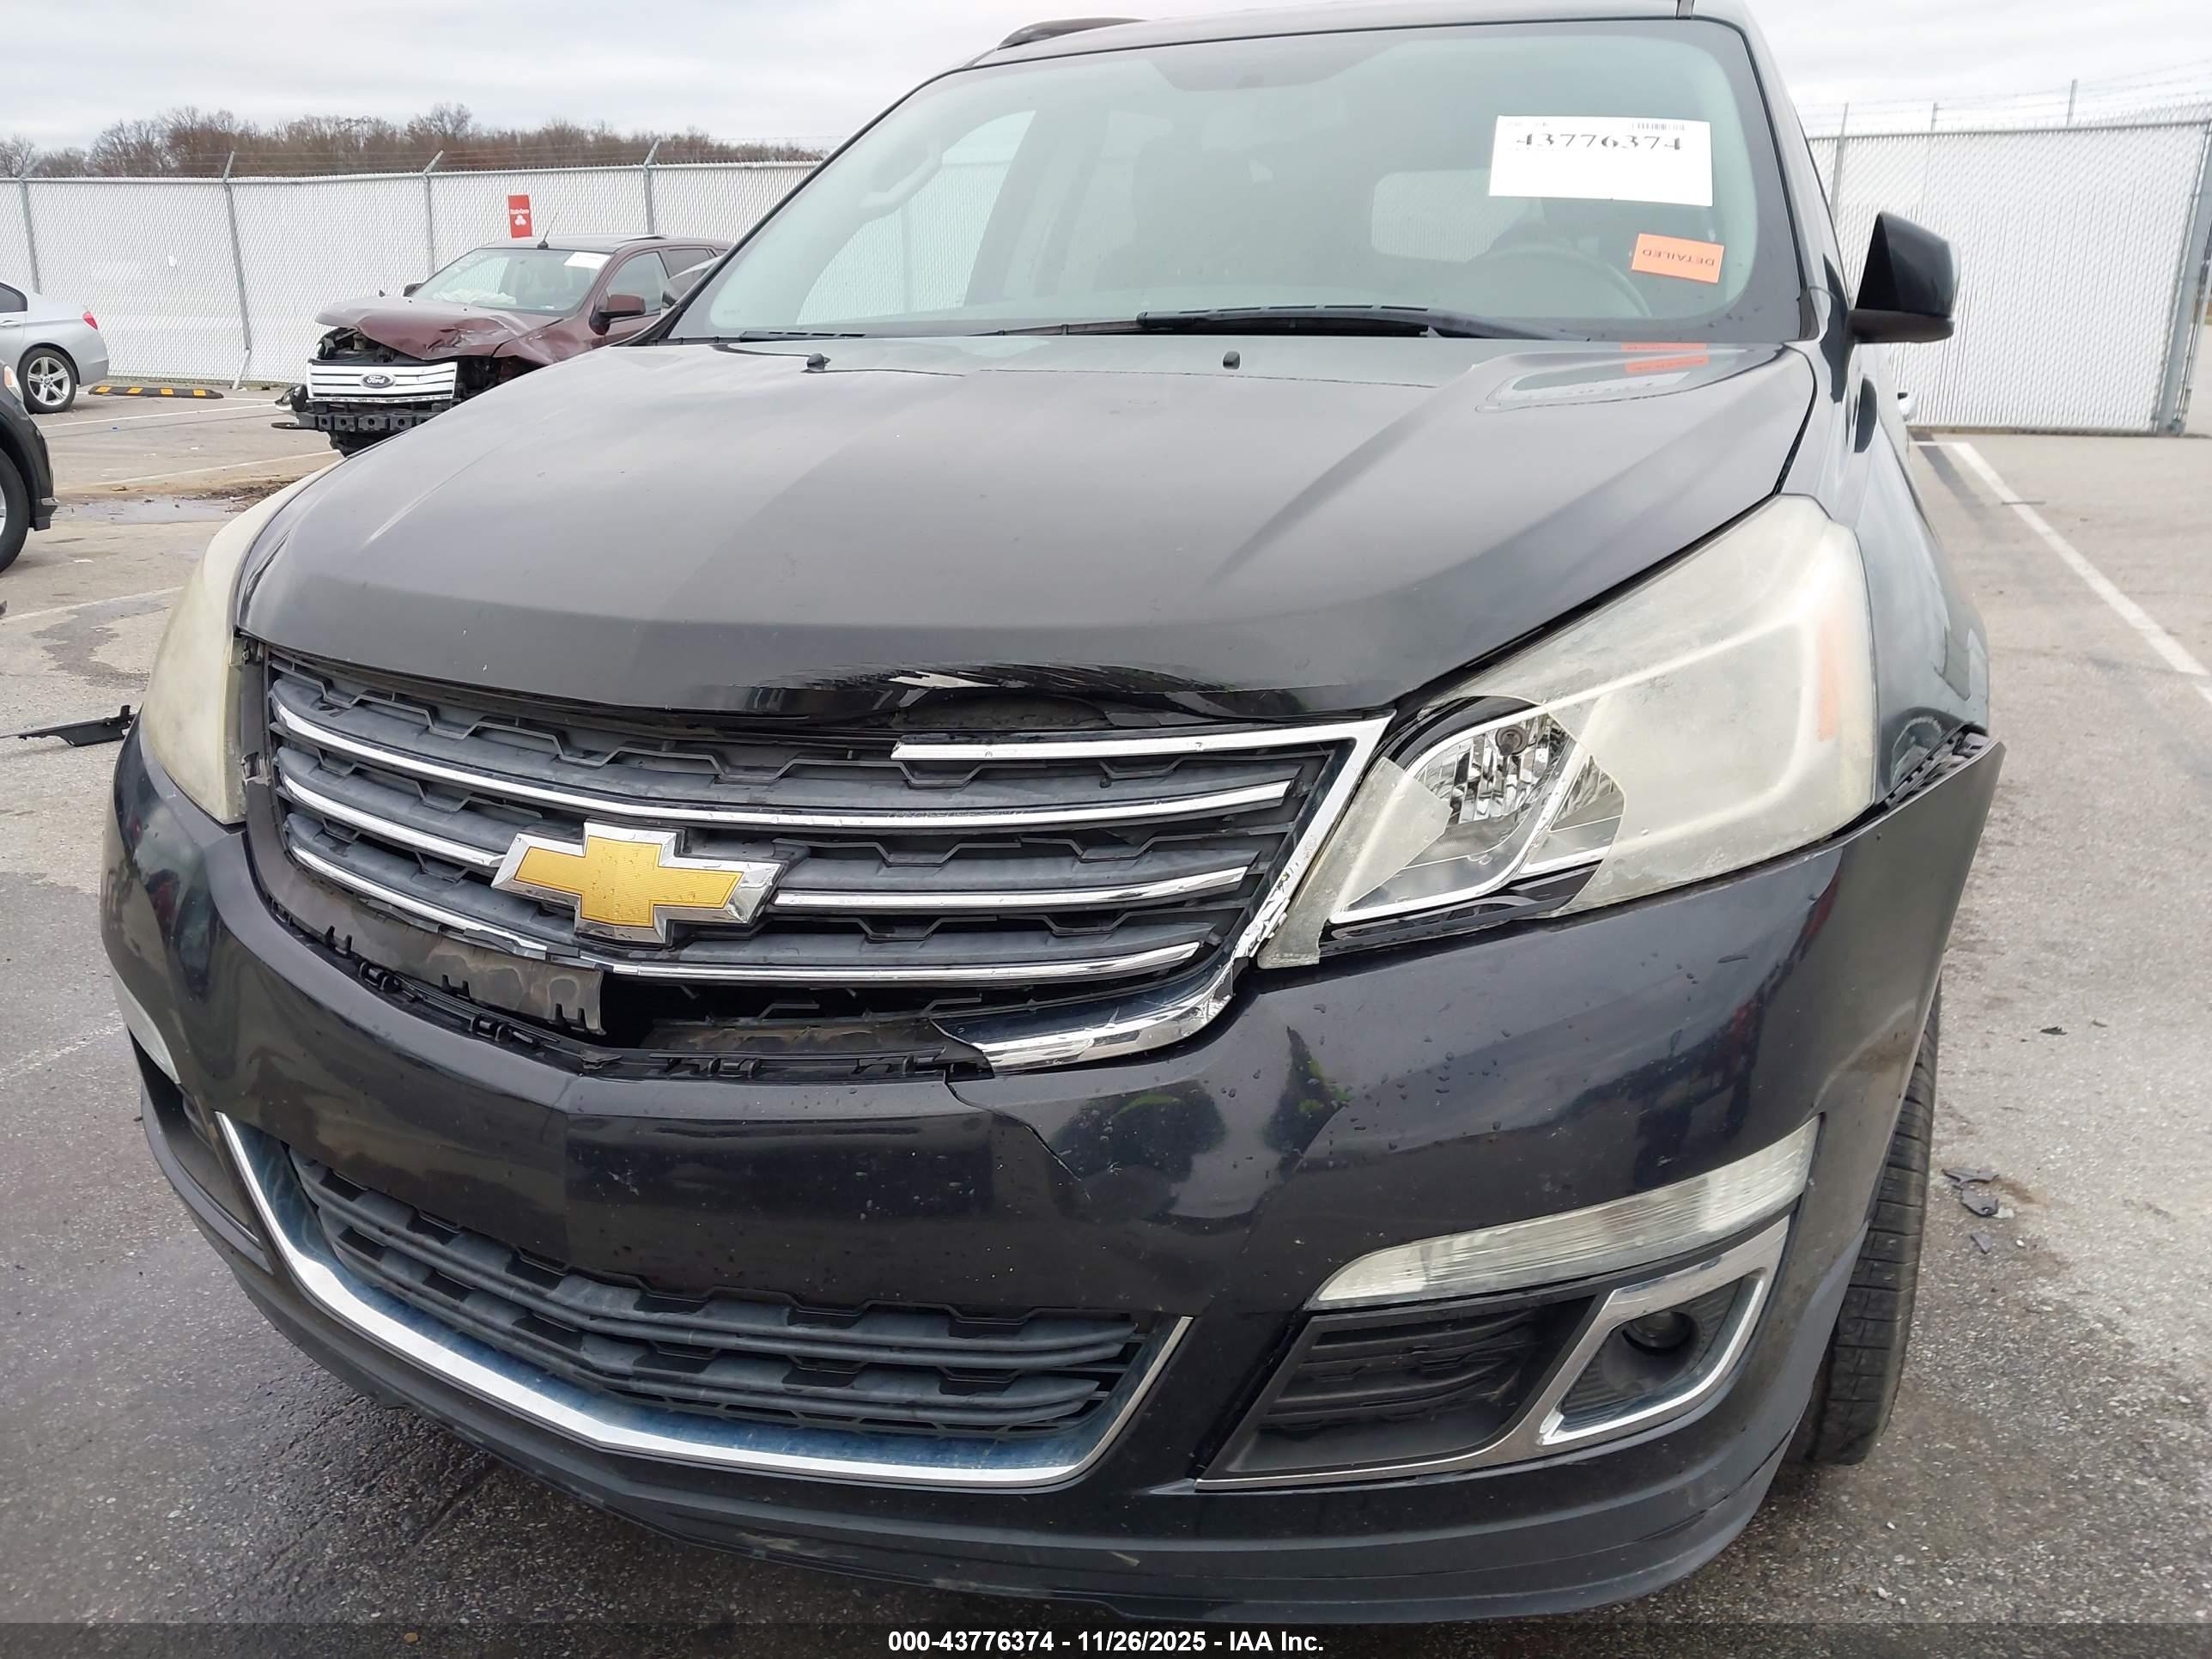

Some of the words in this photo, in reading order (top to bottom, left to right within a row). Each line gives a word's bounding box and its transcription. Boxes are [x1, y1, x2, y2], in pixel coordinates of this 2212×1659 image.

[1516, 132, 1682, 151] 43776374
[1641, 248, 1716, 267] DETAILED
[366, 375, 386, 384] Ford
